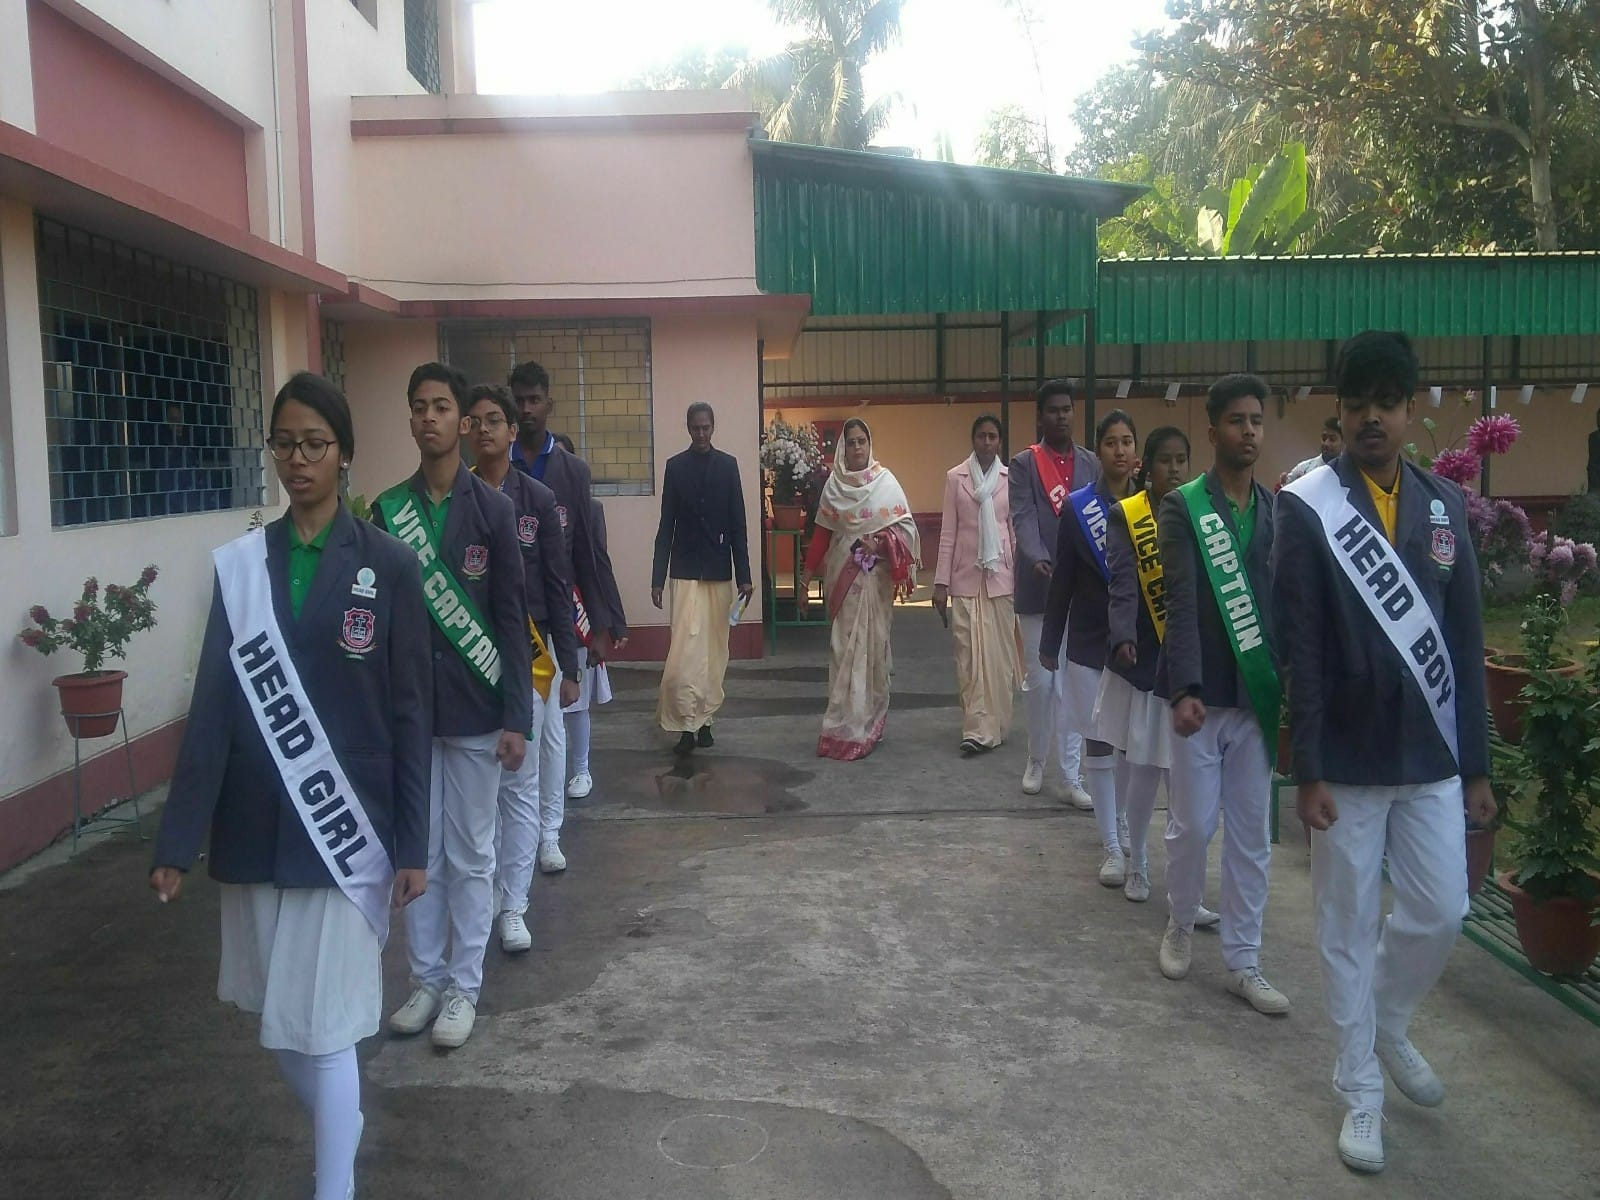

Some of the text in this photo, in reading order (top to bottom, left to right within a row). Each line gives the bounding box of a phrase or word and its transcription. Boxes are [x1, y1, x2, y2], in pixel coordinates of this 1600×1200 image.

[392, 499, 437, 568] VICE
[423, 571, 501, 687] CAPTAIN
[1082, 498, 1107, 552] VICE
[1133, 514, 1160, 573] VICE
[1199, 513, 1263, 653] CAPTAIN
[1334, 513, 1452, 708] HEAD BOY
[237, 630, 370, 878] HEAD GIRL
